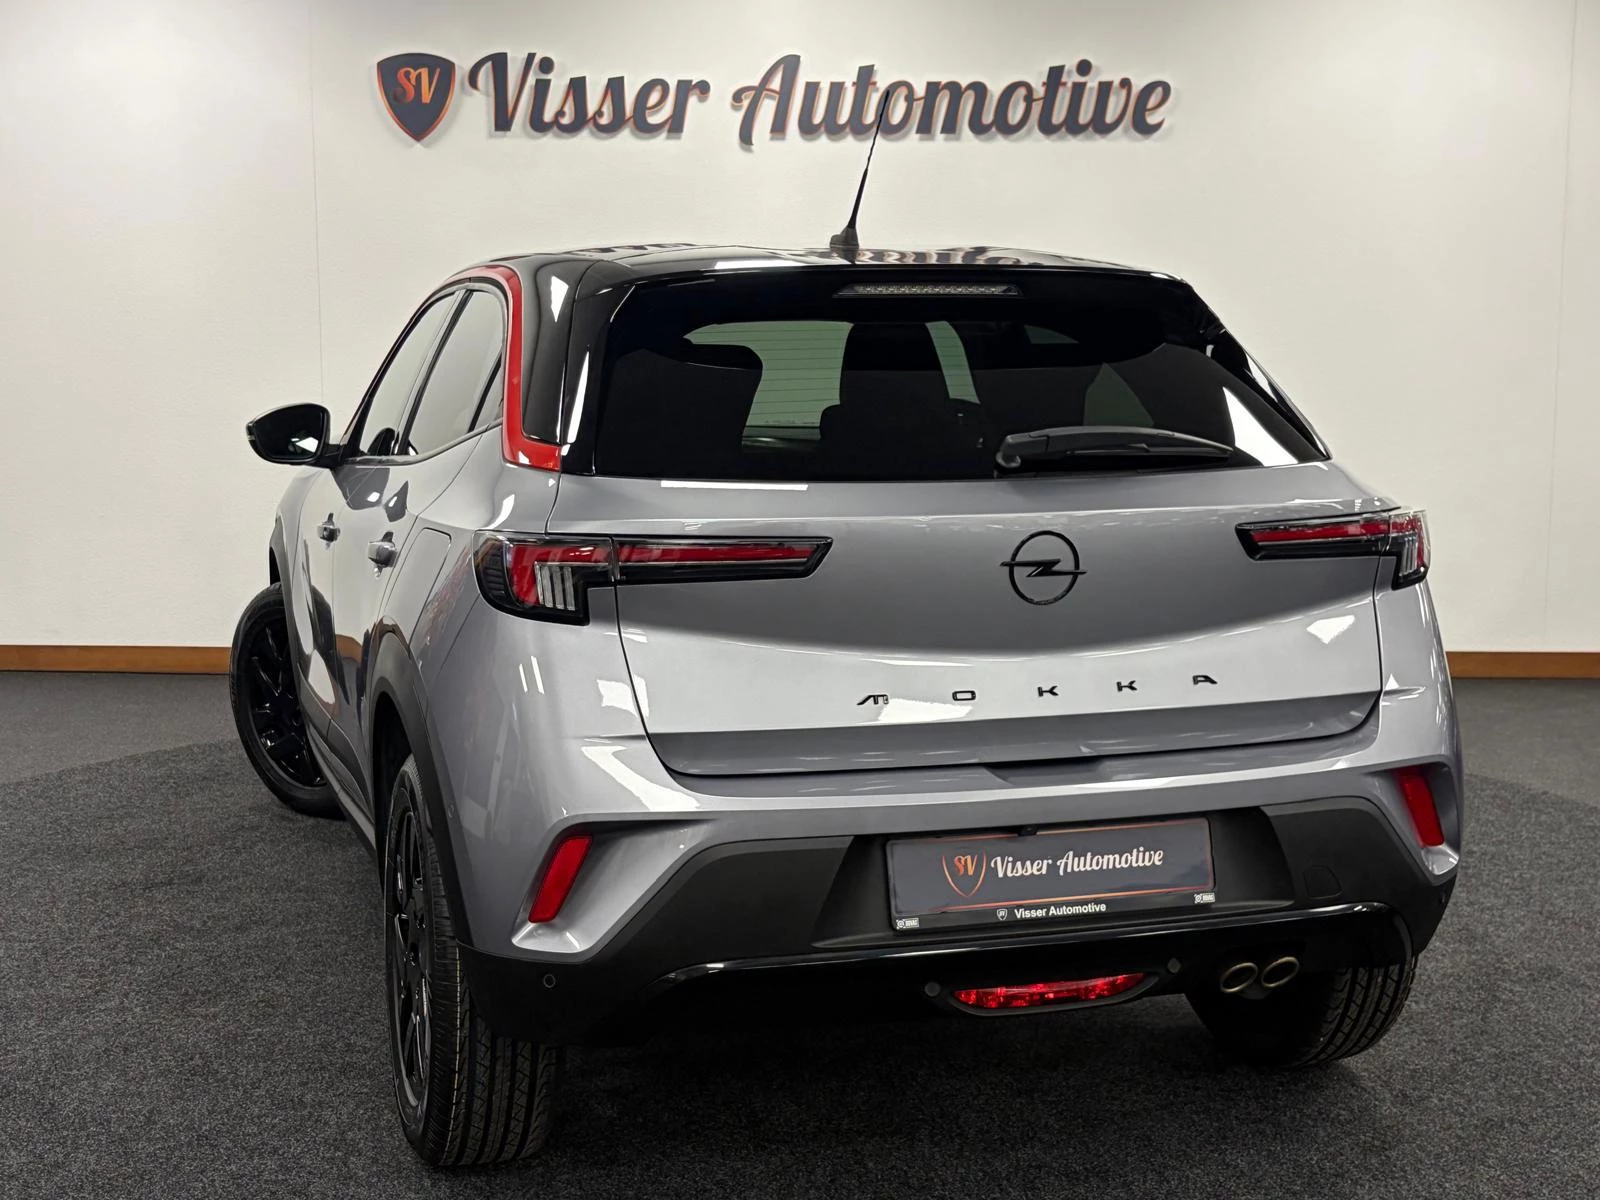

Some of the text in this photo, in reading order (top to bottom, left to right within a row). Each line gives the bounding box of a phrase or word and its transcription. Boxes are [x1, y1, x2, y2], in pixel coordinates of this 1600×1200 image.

[467, 52, 1172, 146] Visser Automotive
[856, 674, 1218, 706] MOKKA
[990, 846, 1164, 878] Visser Automotive
[1014, 907, 1047, 919] Visser
[1048, 902, 1107, 916] Automotive
